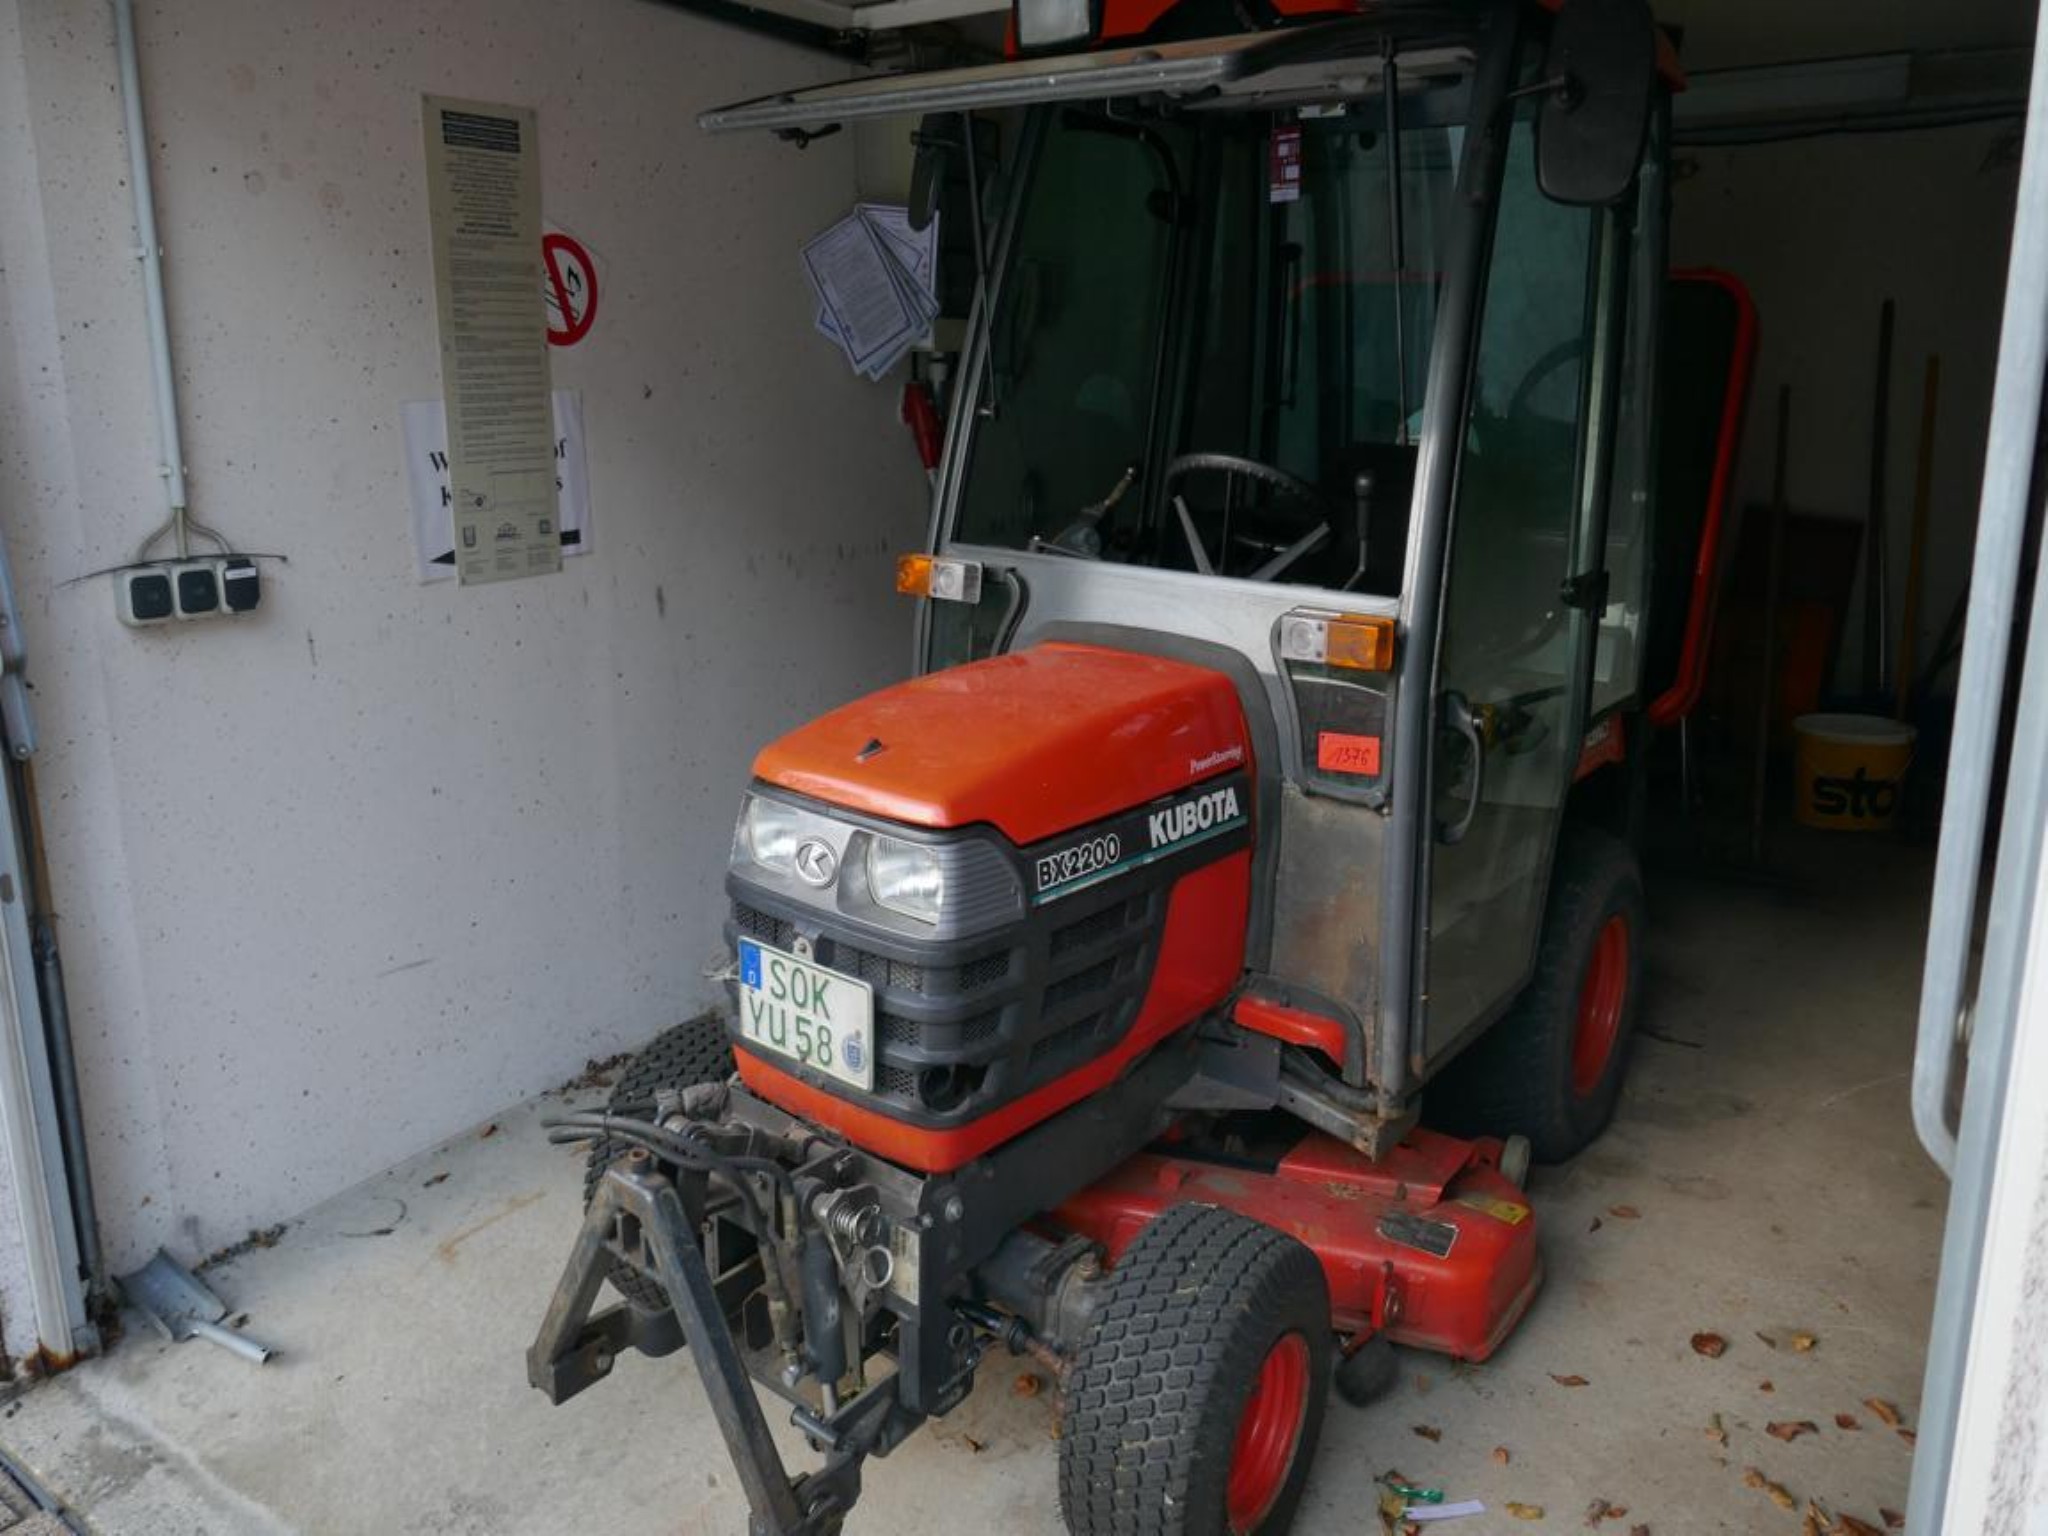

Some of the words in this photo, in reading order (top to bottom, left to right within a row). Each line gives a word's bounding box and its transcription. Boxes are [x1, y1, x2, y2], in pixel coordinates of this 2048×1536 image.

[1148, 787, 1240, 849] KUBOTA
[1036, 833, 1121, 891] BX2200
[769, 958, 831, 1021] SOK
[748, 994, 786, 1048] YU
[795, 1014, 833, 1066] 58
